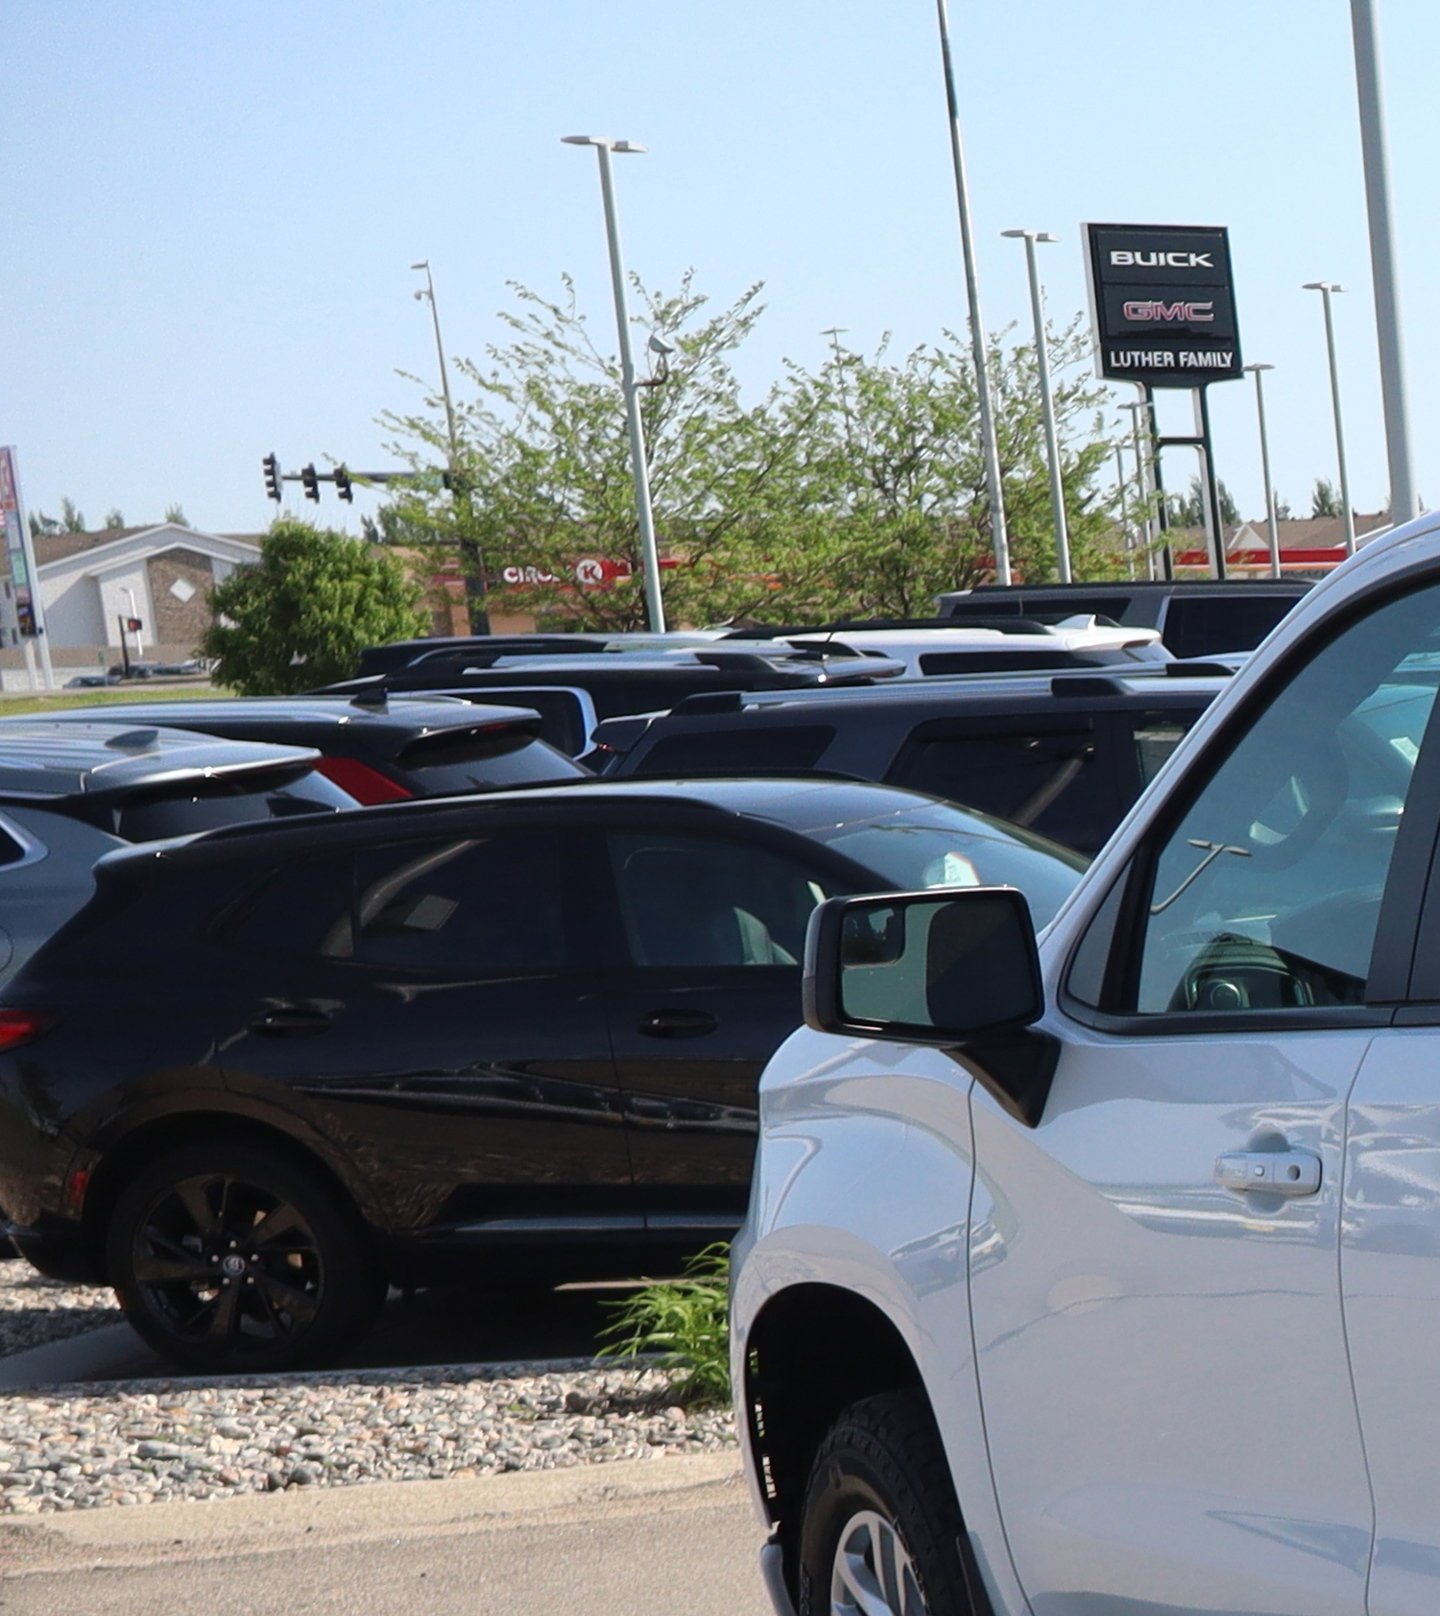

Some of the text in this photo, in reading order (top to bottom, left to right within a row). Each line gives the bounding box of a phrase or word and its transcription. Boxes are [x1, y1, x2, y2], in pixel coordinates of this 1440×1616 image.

[1110, 250, 1214, 267] BUICK
[1123, 300, 1214, 322] GMC
[1111, 351, 1233, 368] LUTHER FAMILY
